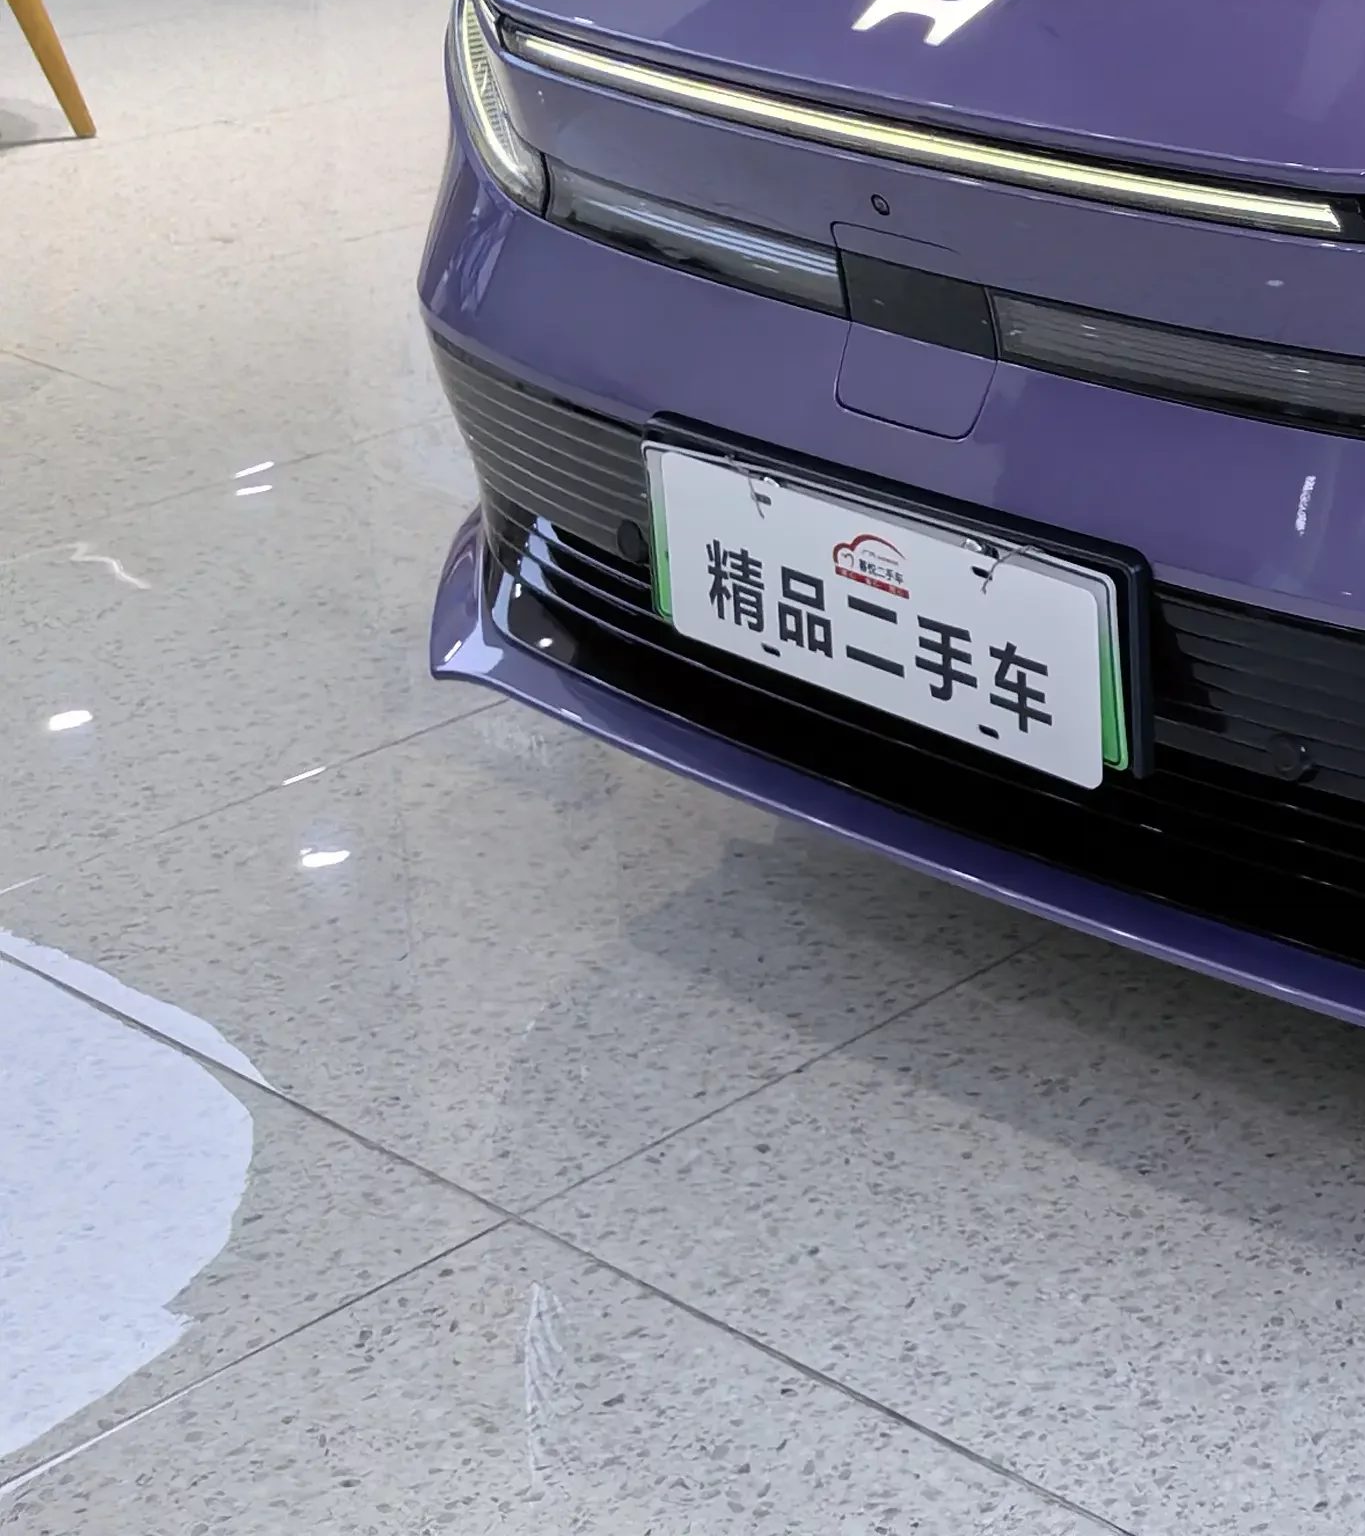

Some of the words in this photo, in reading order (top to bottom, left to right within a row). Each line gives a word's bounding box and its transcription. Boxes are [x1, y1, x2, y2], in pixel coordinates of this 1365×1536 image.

[704, 538, 1054, 734] 精品二手车
